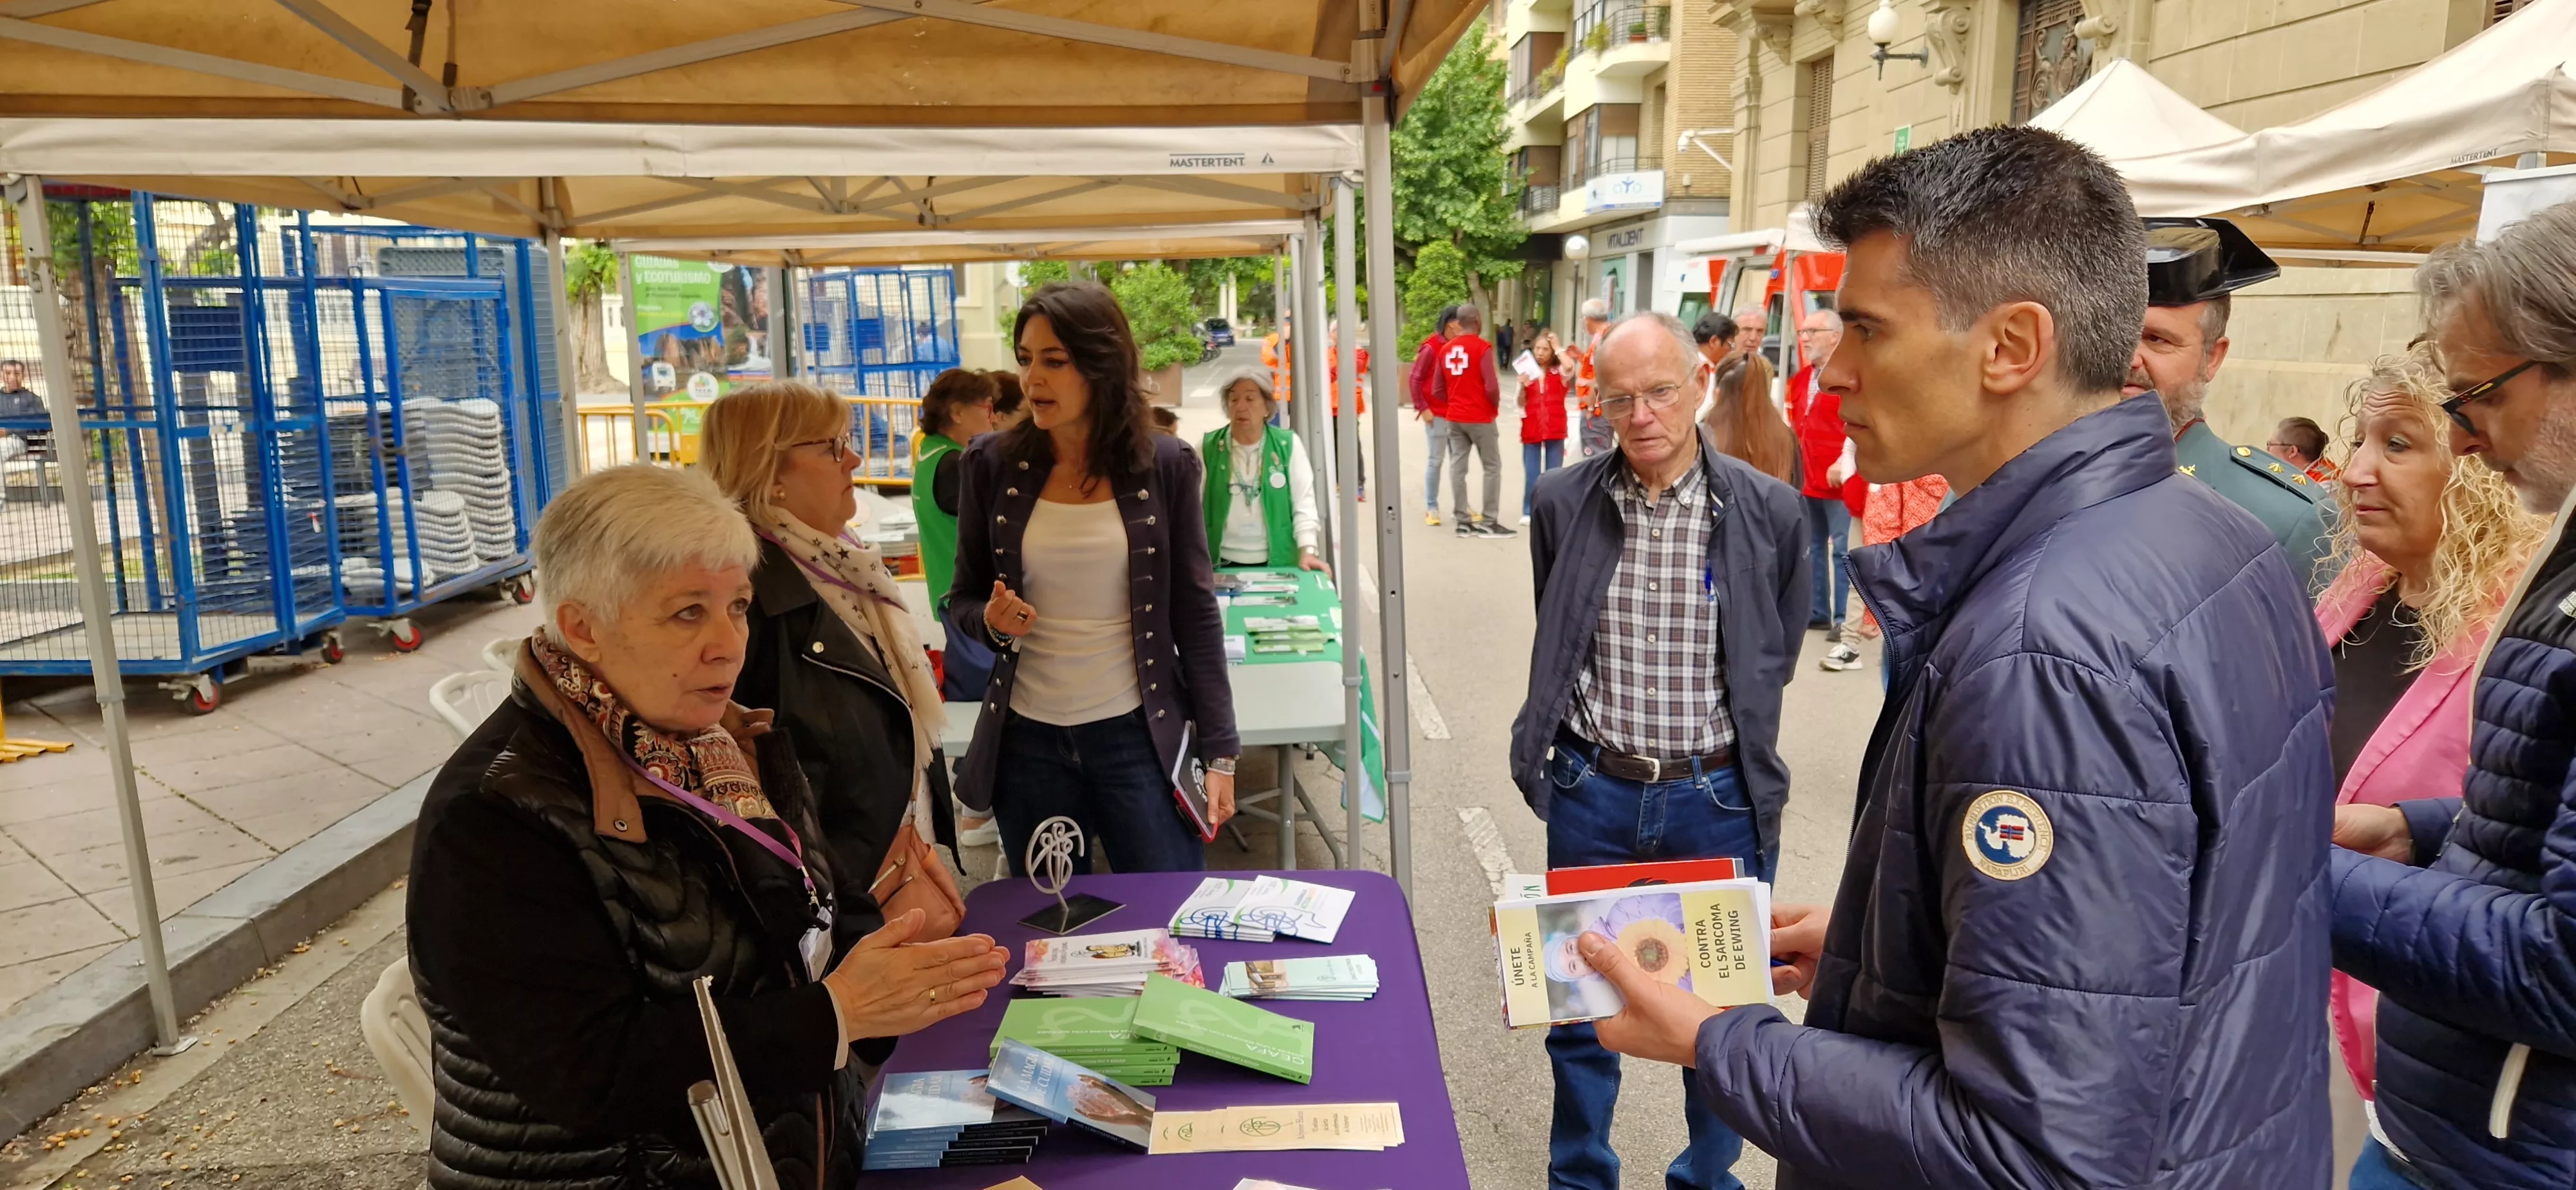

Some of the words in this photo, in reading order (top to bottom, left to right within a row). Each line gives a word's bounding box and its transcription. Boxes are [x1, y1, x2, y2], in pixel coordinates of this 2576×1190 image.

[1170, 156, 1245, 167] MASTERTENT
[2450, 147, 2499, 165] MASTERTENT
[1607, 228, 1644, 249] VITALDENT
[1710, 903, 1728, 961] SARCOMA
[1728, 910, 1743, 952] EWING
[1524, 932, 1536, 970] CAMPAÑA
[1695, 919, 1711, 968] CONTRA
[1511, 947, 1524, 986] ÚNETE
[1718, 964, 1730, 978] EL
[1734, 954, 1746, 970] DE
[1530, 971, 1537, 981] LA
[1245, 1043, 1305, 1066] CEAFA
[1021, 1053, 1039, 1080] MAGIA
